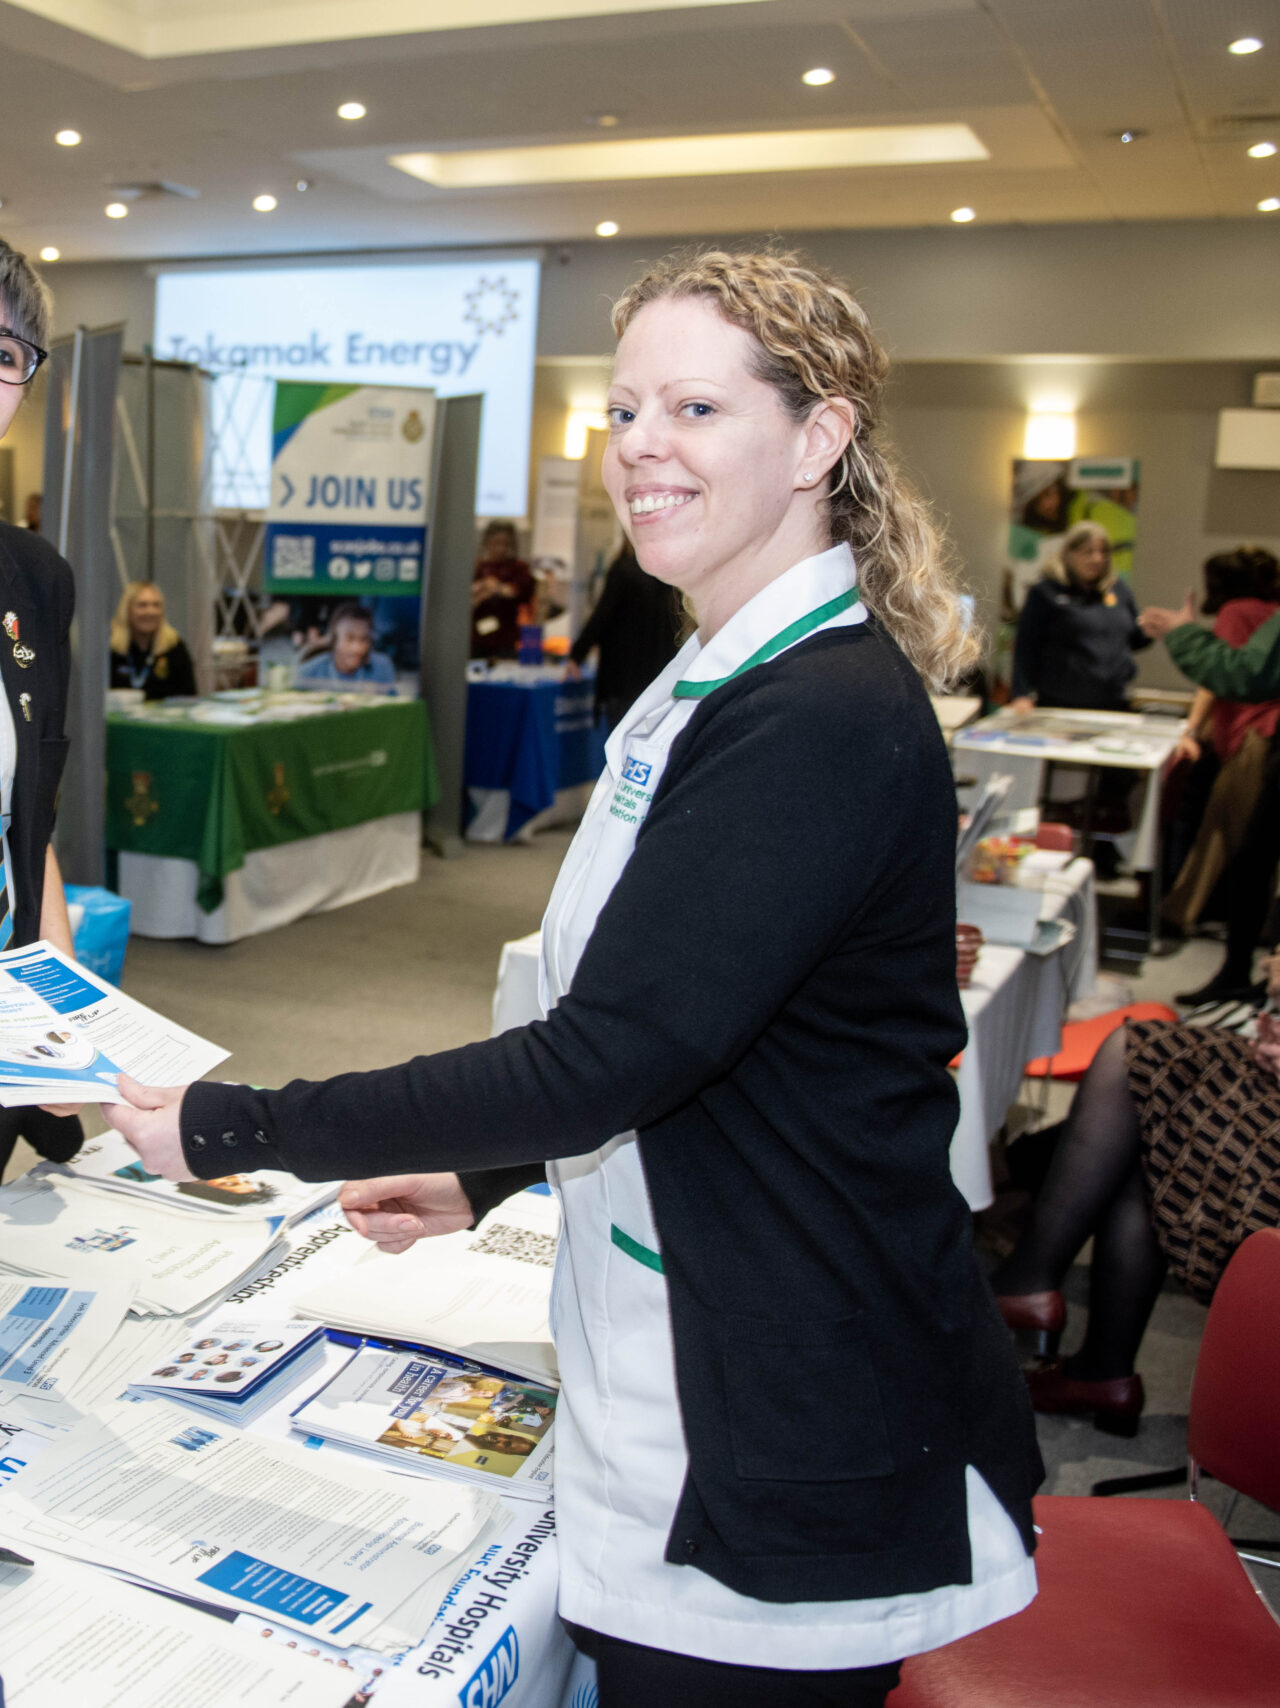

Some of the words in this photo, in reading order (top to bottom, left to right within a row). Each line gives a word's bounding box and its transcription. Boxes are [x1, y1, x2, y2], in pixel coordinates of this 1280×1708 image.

[170, 333, 332, 367] Tokamak
[346, 335, 482, 377] Energy
[306, 475, 377, 509] JOIN
[388, 479, 423, 511] US
[225, 1223, 354, 1306] Apprenticeships
[391, 1371, 416, 1394] health
[417, 1592, 507, 1679] Hospitals
